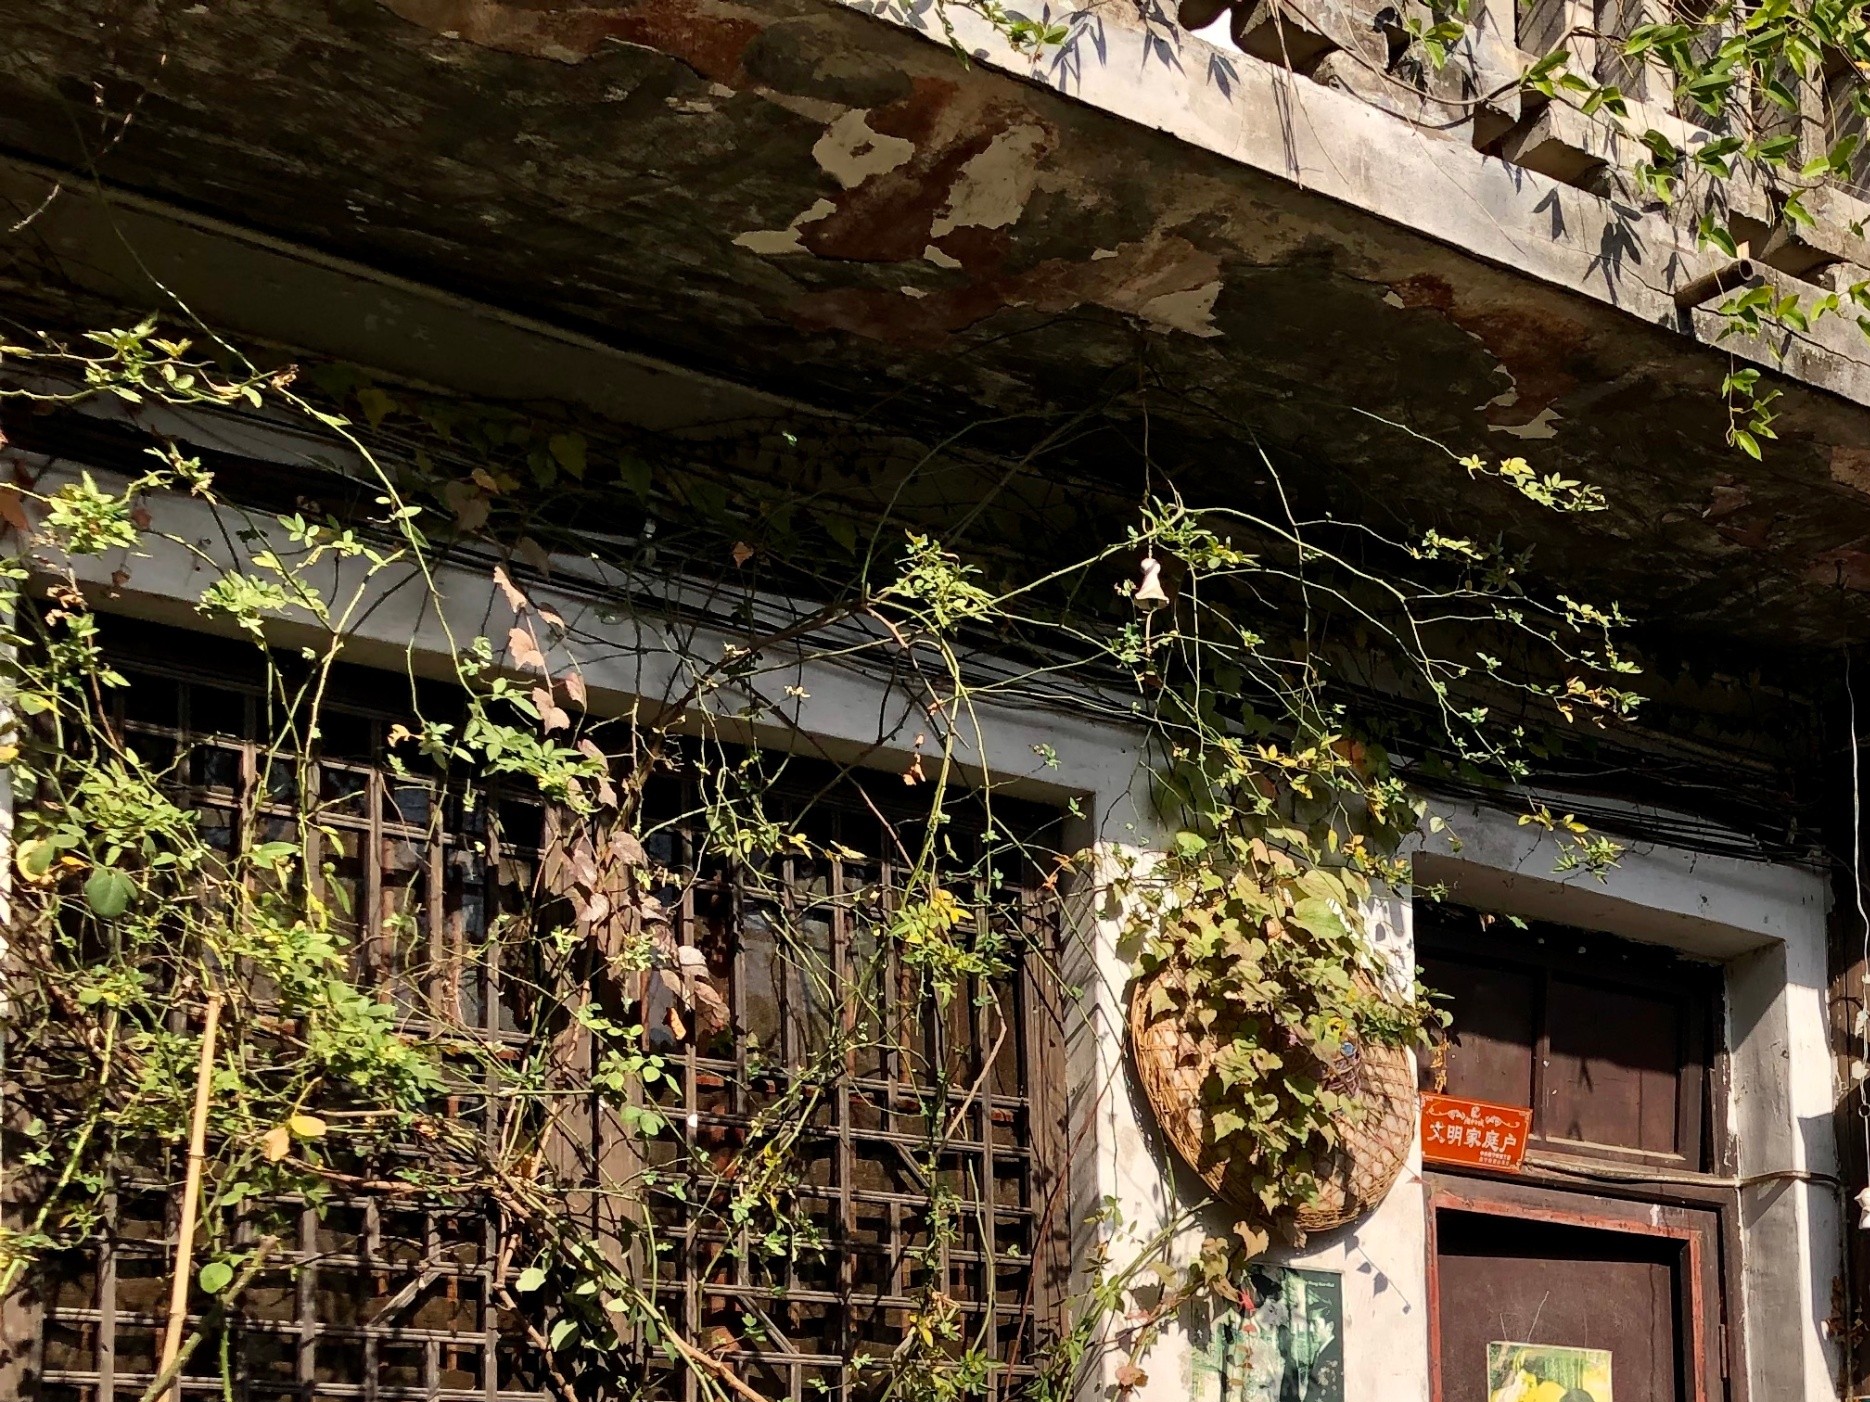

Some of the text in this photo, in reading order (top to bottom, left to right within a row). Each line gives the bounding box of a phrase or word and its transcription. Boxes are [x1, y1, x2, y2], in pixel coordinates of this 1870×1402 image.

[1427, 1121, 1517, 1151] 文明家庭户
